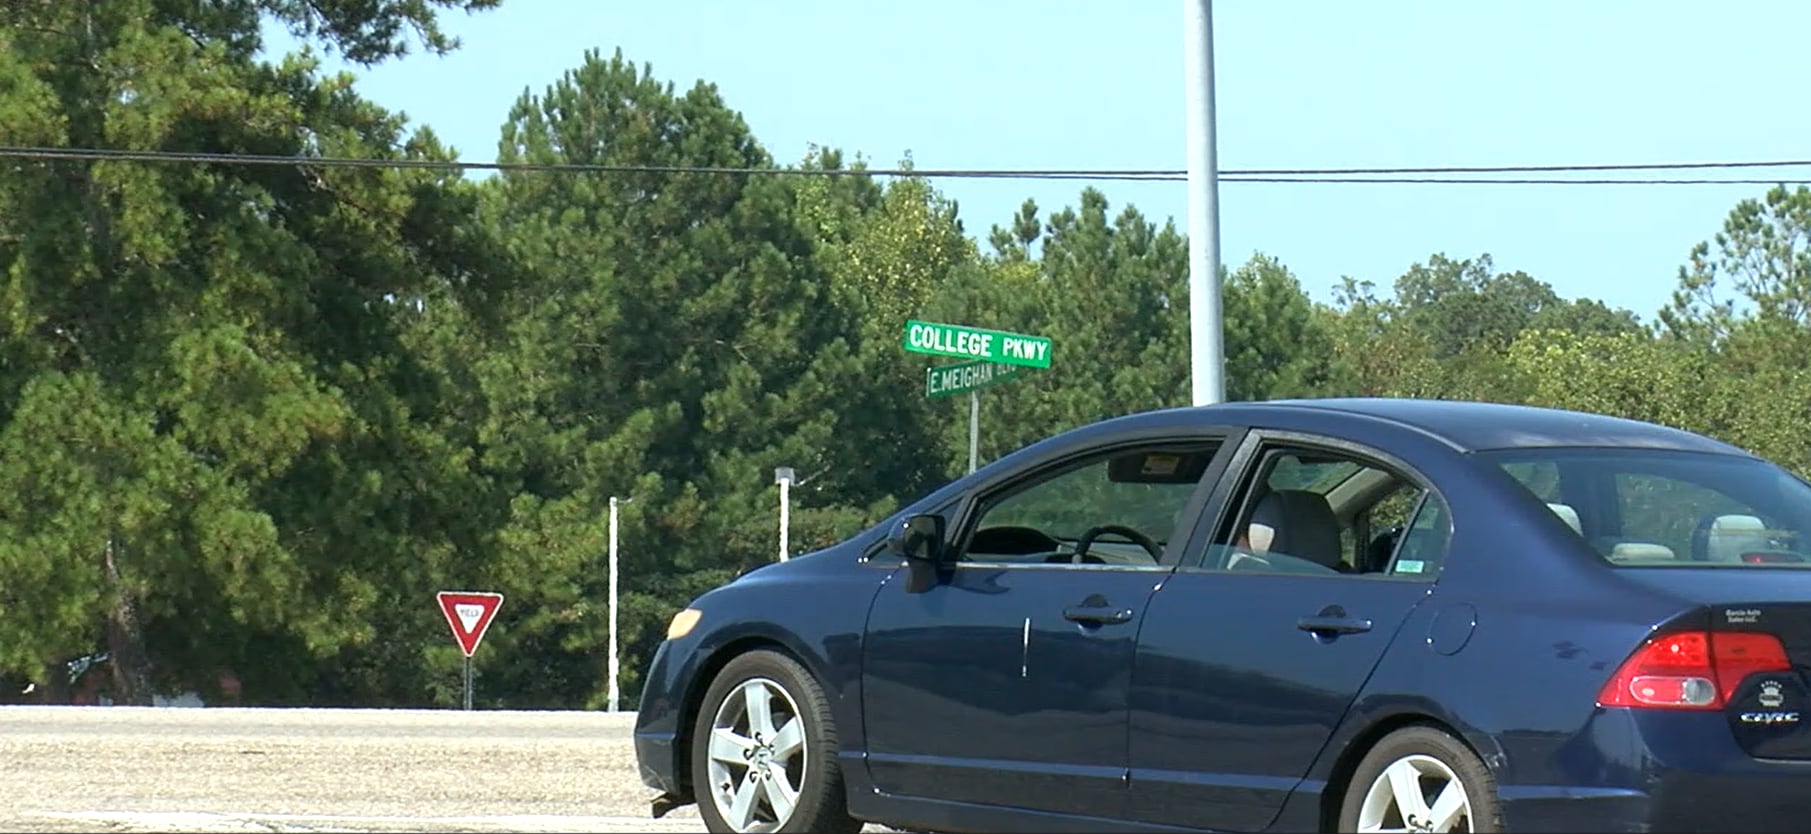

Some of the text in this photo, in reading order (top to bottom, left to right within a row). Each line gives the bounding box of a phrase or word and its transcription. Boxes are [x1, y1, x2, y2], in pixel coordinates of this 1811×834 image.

[909, 324, 1048, 361] COLLEGE PKWY
[1740, 712, 1799, 724] CIVIC
